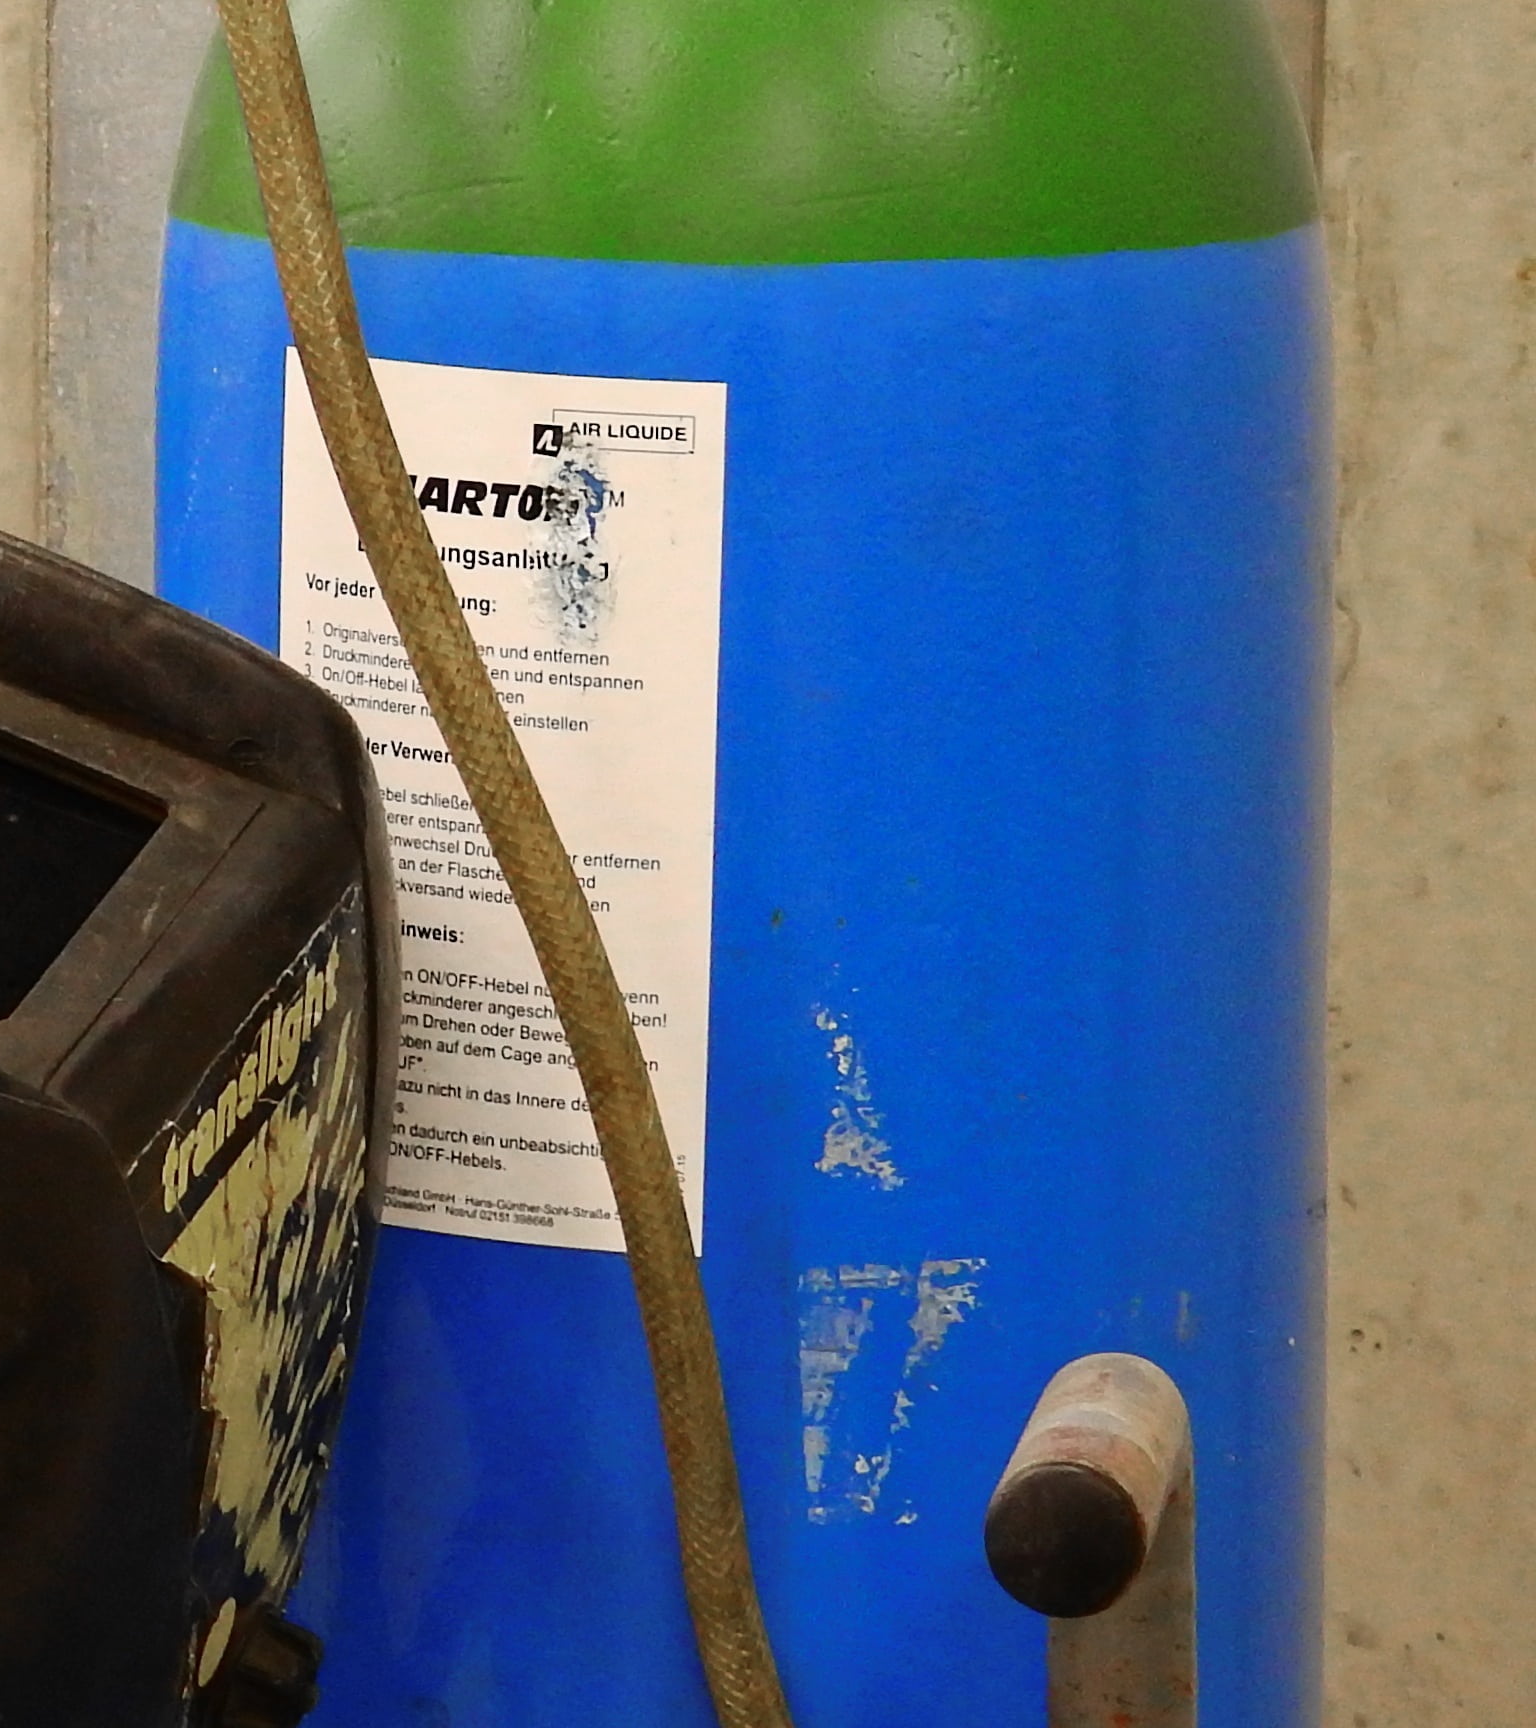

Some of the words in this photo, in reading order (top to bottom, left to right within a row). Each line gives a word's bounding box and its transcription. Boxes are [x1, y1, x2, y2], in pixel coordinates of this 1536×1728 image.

[568, 421, 601, 438] AIR
[607, 423, 688, 442] LIQUIDE
[306, 572, 331, 592] Vor
[334, 578, 376, 599] jeder
[499, 645, 529, 661] und
[533, 647, 610, 667] entfernen
[321, 665, 408, 693] On/Off-Hebel
[514, 668, 544, 685] und
[548, 671, 645, 693] entspannen
[513, 712, 590, 733] einstellen
[398, 858, 416, 871] an
[419, 857, 444, 875] der
[582, 852, 661, 872] entfernen
[400, 919, 465, 944] inweis:
[417, 968, 530, 996] ON/OFF-Hebel
[402, 990, 483, 1014] ckminderer
[630, 1012, 668, 1029] ben!
[422, 1013, 477, 1035] Drehen
[480, 1022, 516, 1040] oder
[435, 1039, 460, 1056] auf
[462, 1041, 497, 1060] dem
[500, 1045, 543, 1066] Cage
[427, 1080, 462, 1102] nicht
[465, 1086, 479, 1102] in
[482, 1087, 512, 1106] das
[515, 1089, 566, 1111] Innere
[409, 1122, 469, 1145] dadurch
[471, 1131, 495, 1148] ein
